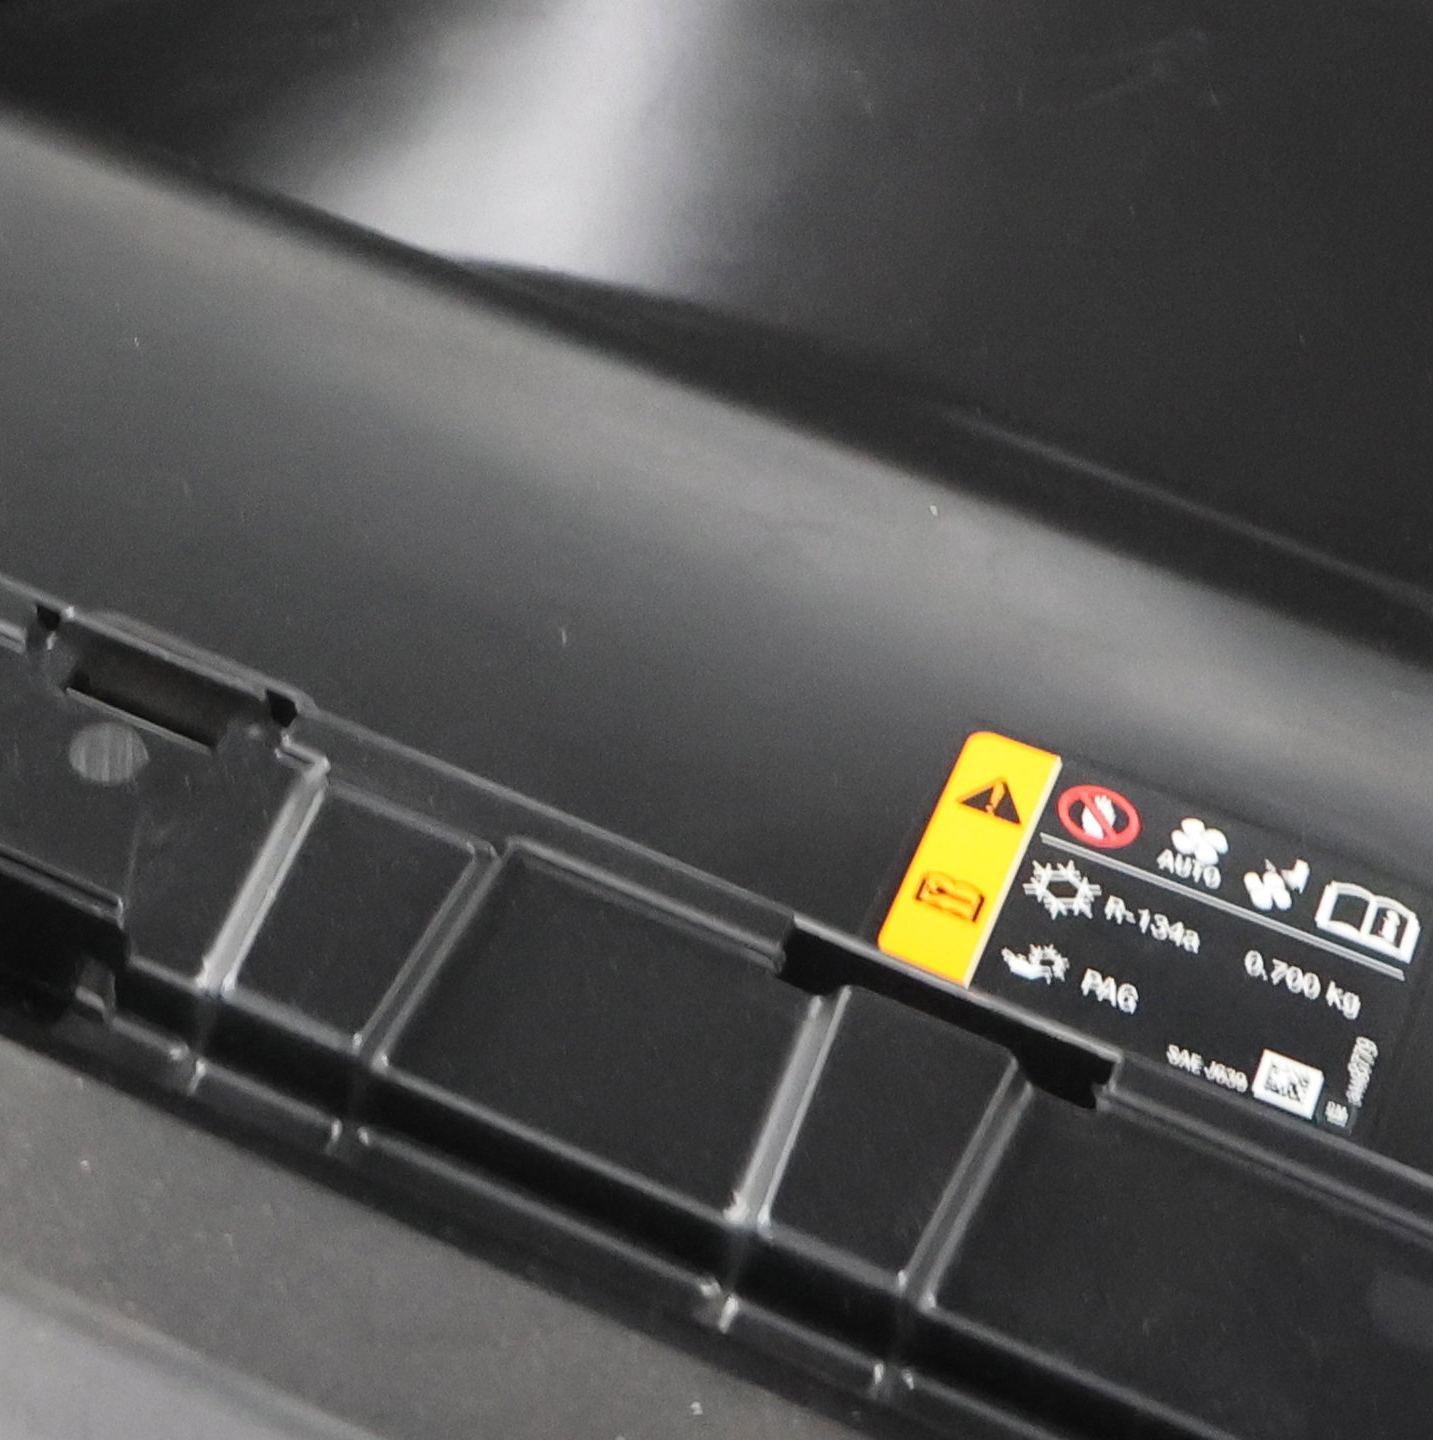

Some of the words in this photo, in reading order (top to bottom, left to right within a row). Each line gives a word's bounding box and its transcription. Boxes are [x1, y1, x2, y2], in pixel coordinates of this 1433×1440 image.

[1158, 849, 1221, 889] AUTO
[1104, 895, 1201, 954] R-134a
[1244, 950, 1320, 1000] 0.700
[1326, 981, 1361, 1020] kg
[1081, 968, 1139, 1015] PAG
[1166, 1043, 1204, 1076] SAE
